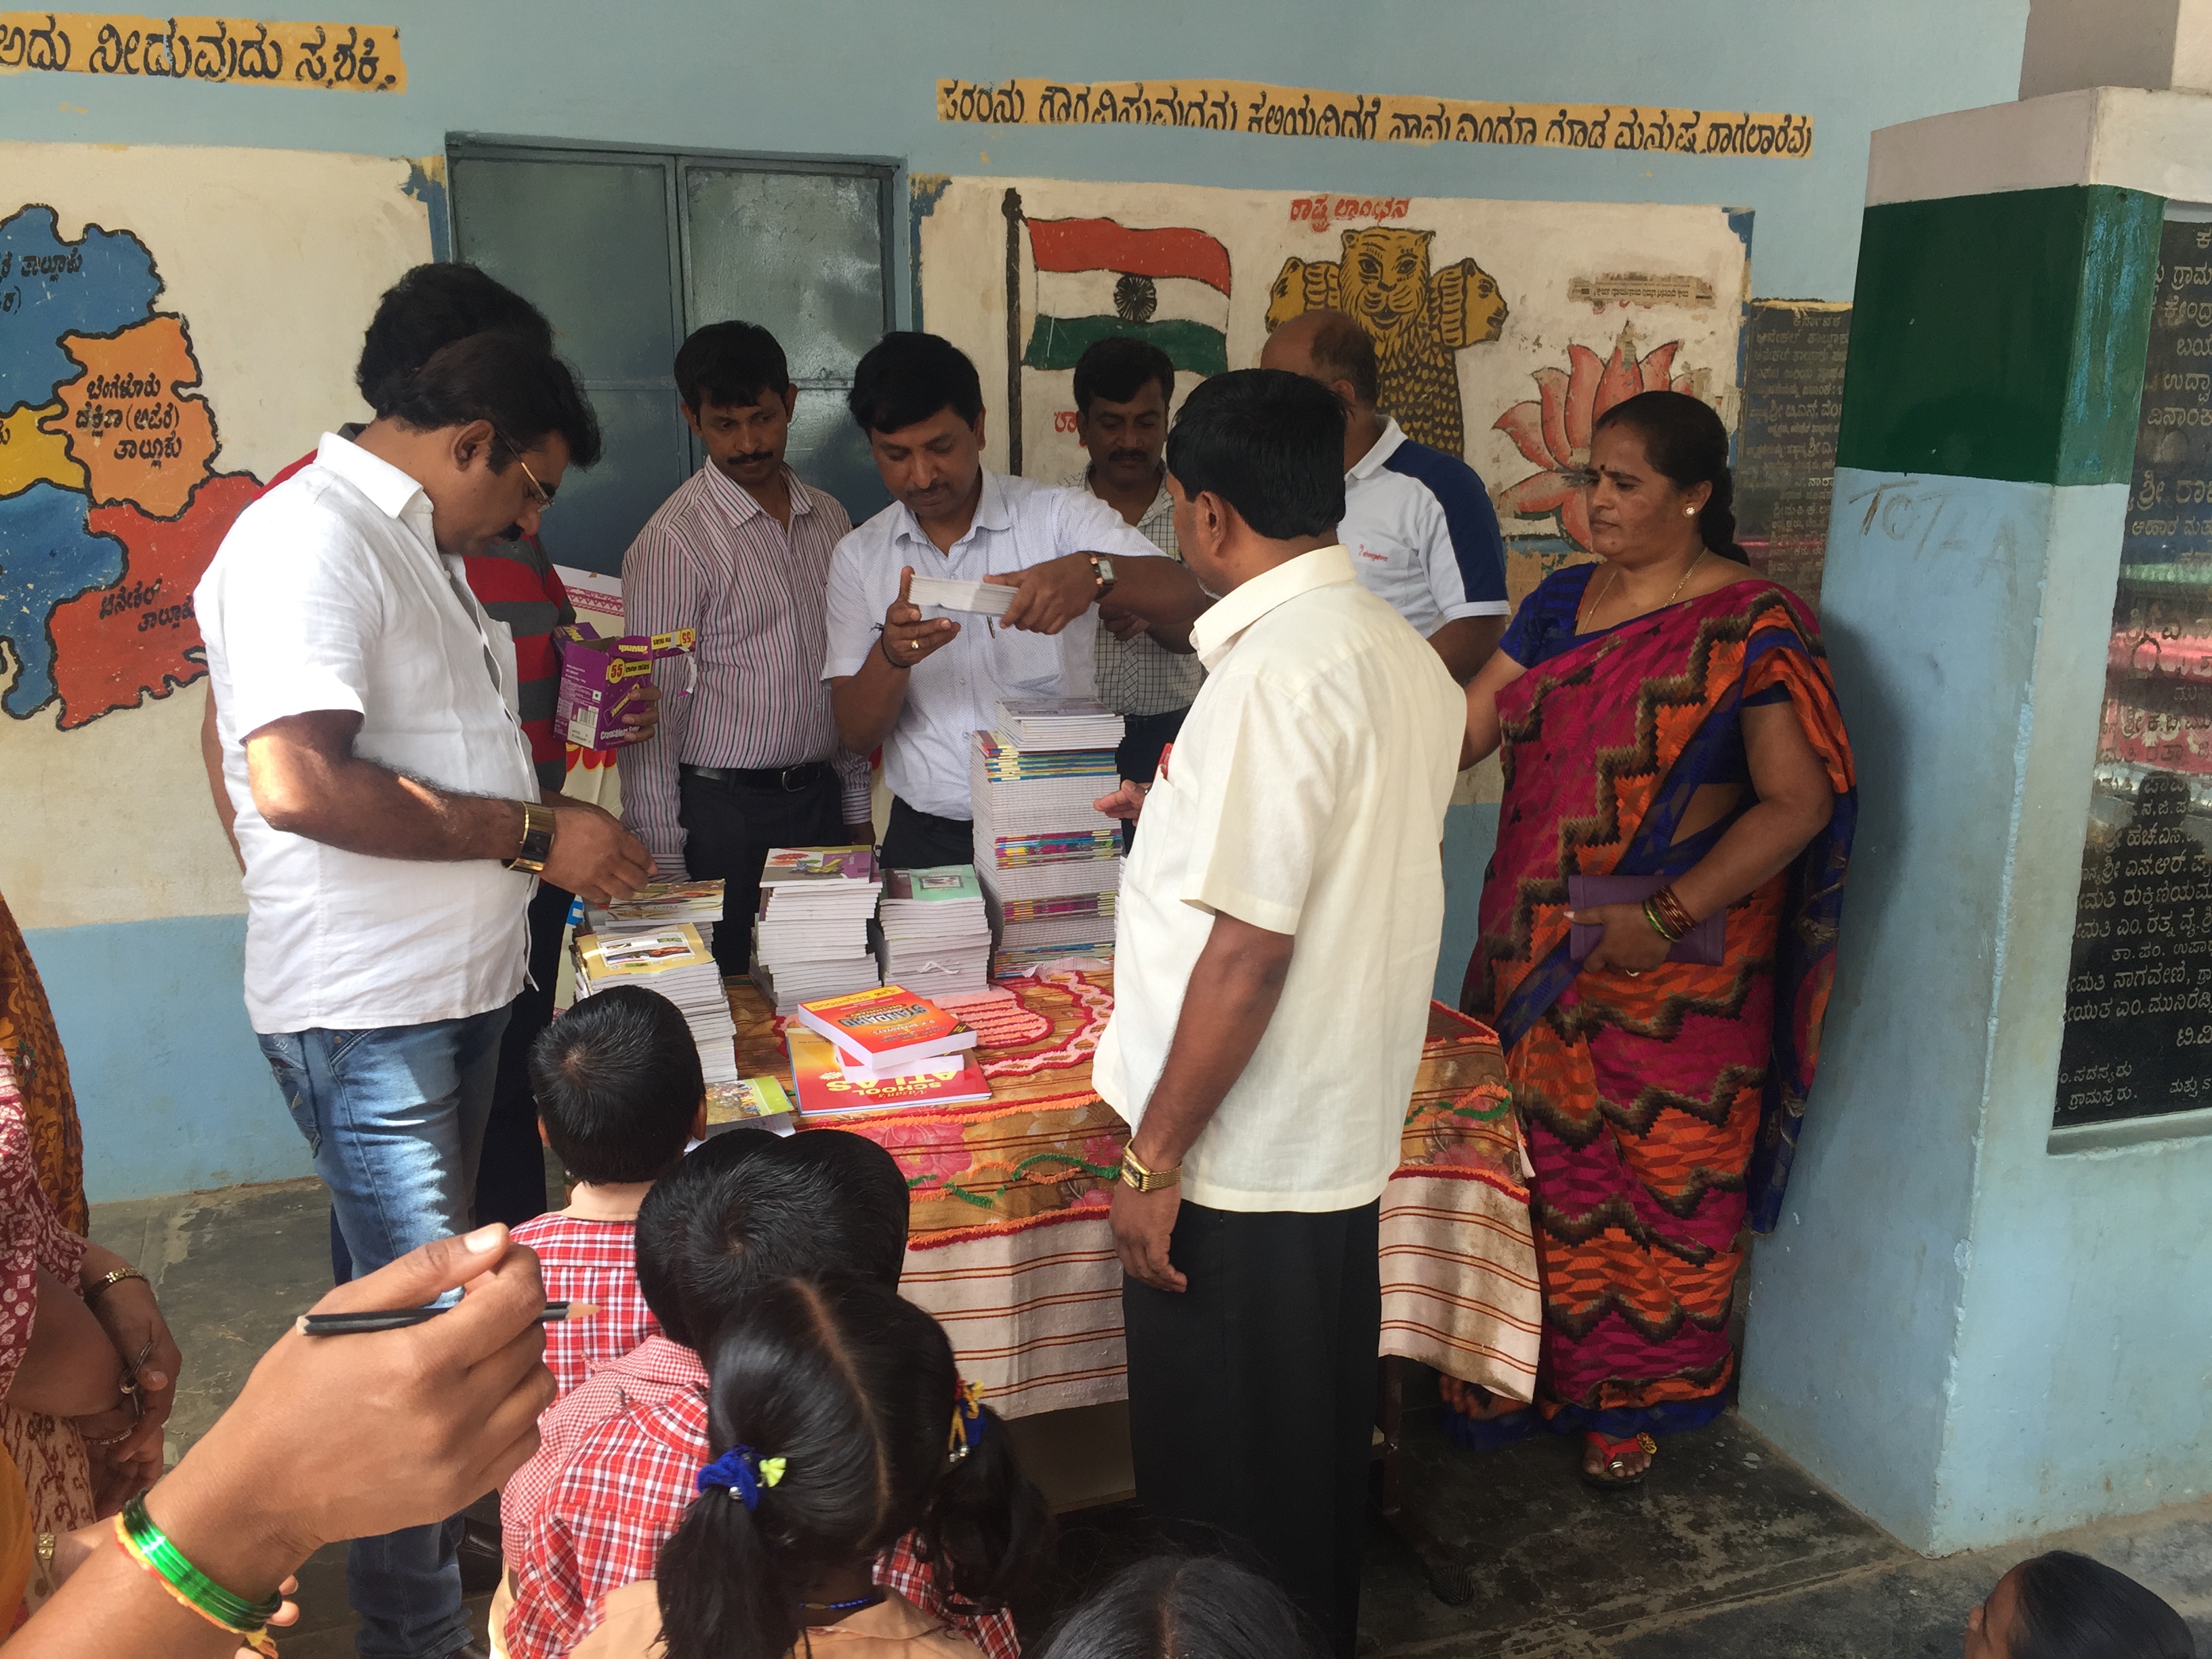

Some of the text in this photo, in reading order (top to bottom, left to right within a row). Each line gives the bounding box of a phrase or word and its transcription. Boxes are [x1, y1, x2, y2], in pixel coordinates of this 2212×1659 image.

[0, 13, 70, 72] ಅದು
[89, 17, 282, 82] ನೀಡುವುದು
[1290, 194, 1330, 232] ರಾಷ್ಟ್ರ
[86, 372, 161, 400] ಬೆಂಗಳೂರು
[114, 430, 182, 470] ತಾಲ್ಲೂಕು
[2131, 516, 2179, 535] ಆಹಾರ
[611, 664, 623, 678] 55
[2147, 911, 2175, 937] ರತ್ನ
[838, 1004, 930, 1027] STANDARD
[852, 1082, 942, 1096] SCHOOL
